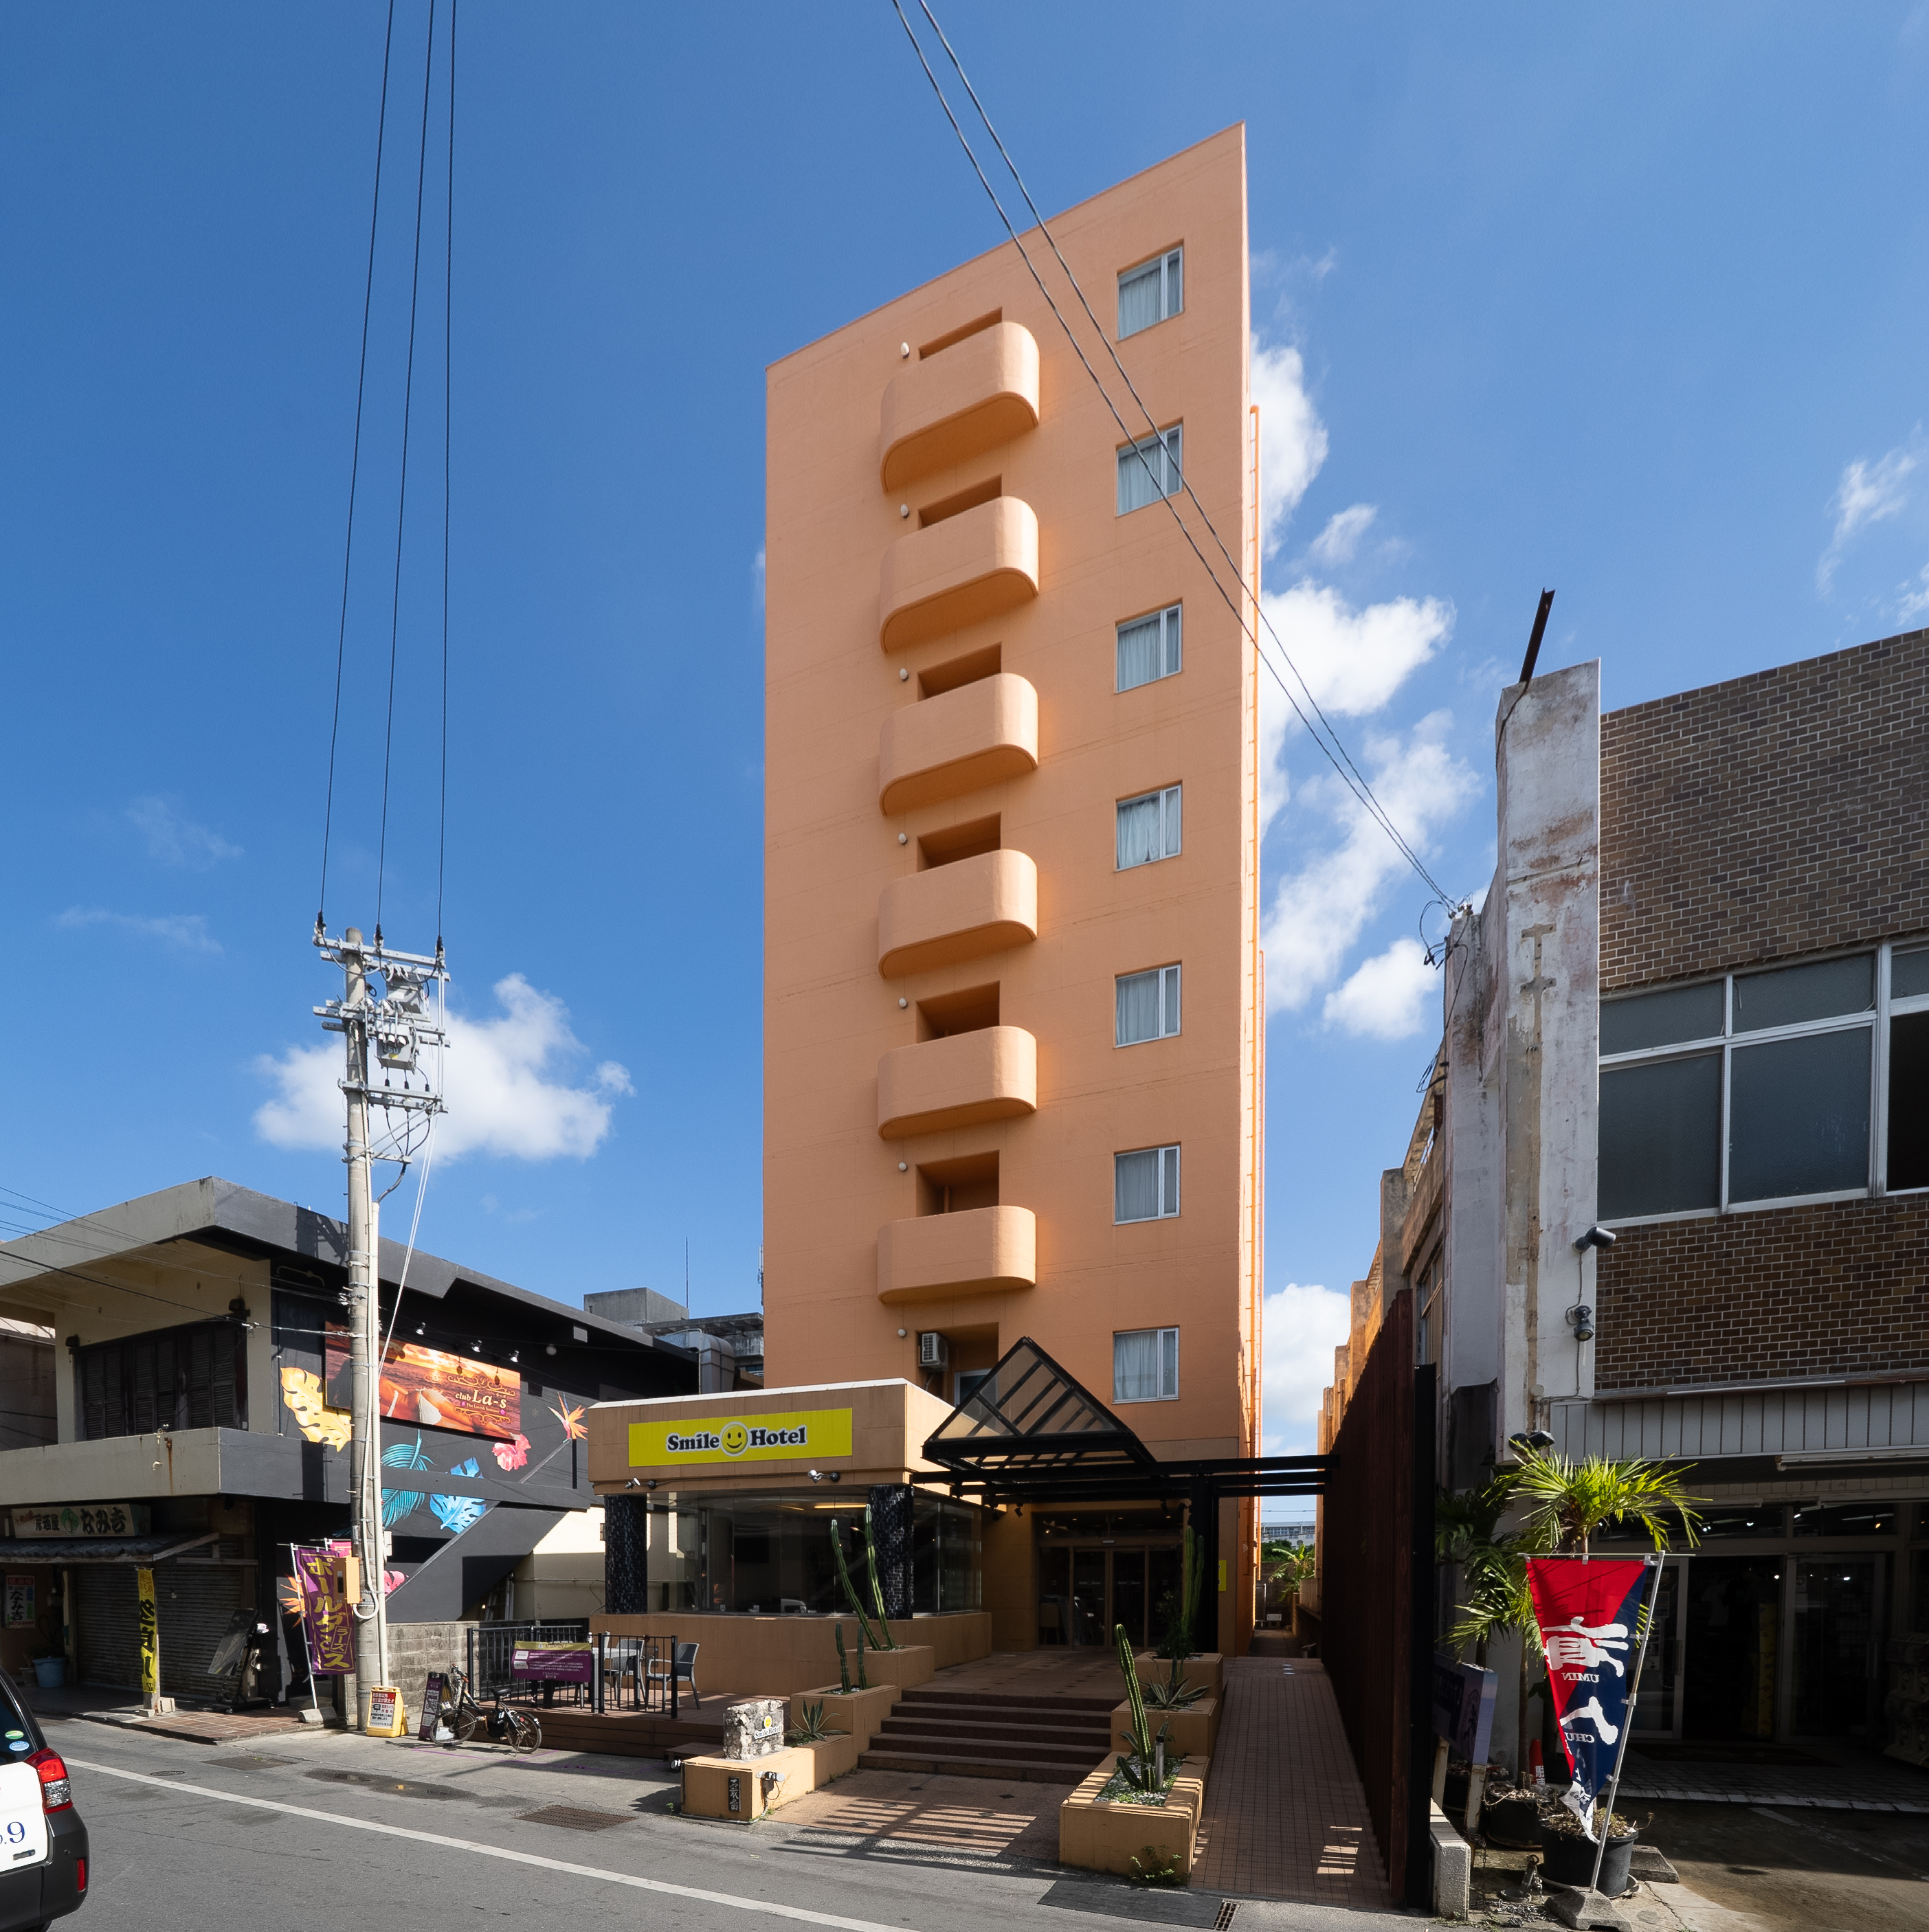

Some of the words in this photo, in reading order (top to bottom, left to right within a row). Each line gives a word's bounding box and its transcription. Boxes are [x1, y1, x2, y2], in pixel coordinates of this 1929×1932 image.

[455, 1392, 471, 1401] club
[471, 1389, 507, 1409] La-s
[667, 1433, 720, 1451] Smile
[750, 1426, 807, 1446] Hotel
[35, 1514, 60, 1531] 居酒屋
[80, 1506, 127, 1534] なみ吉
[10, 1590, 25, 1621] なみ吉
[335, 1628, 348, 1652] ラーズ
[755, 1731, 768, 1739] Smile
[768, 1725, 781, 1735] Hotel
